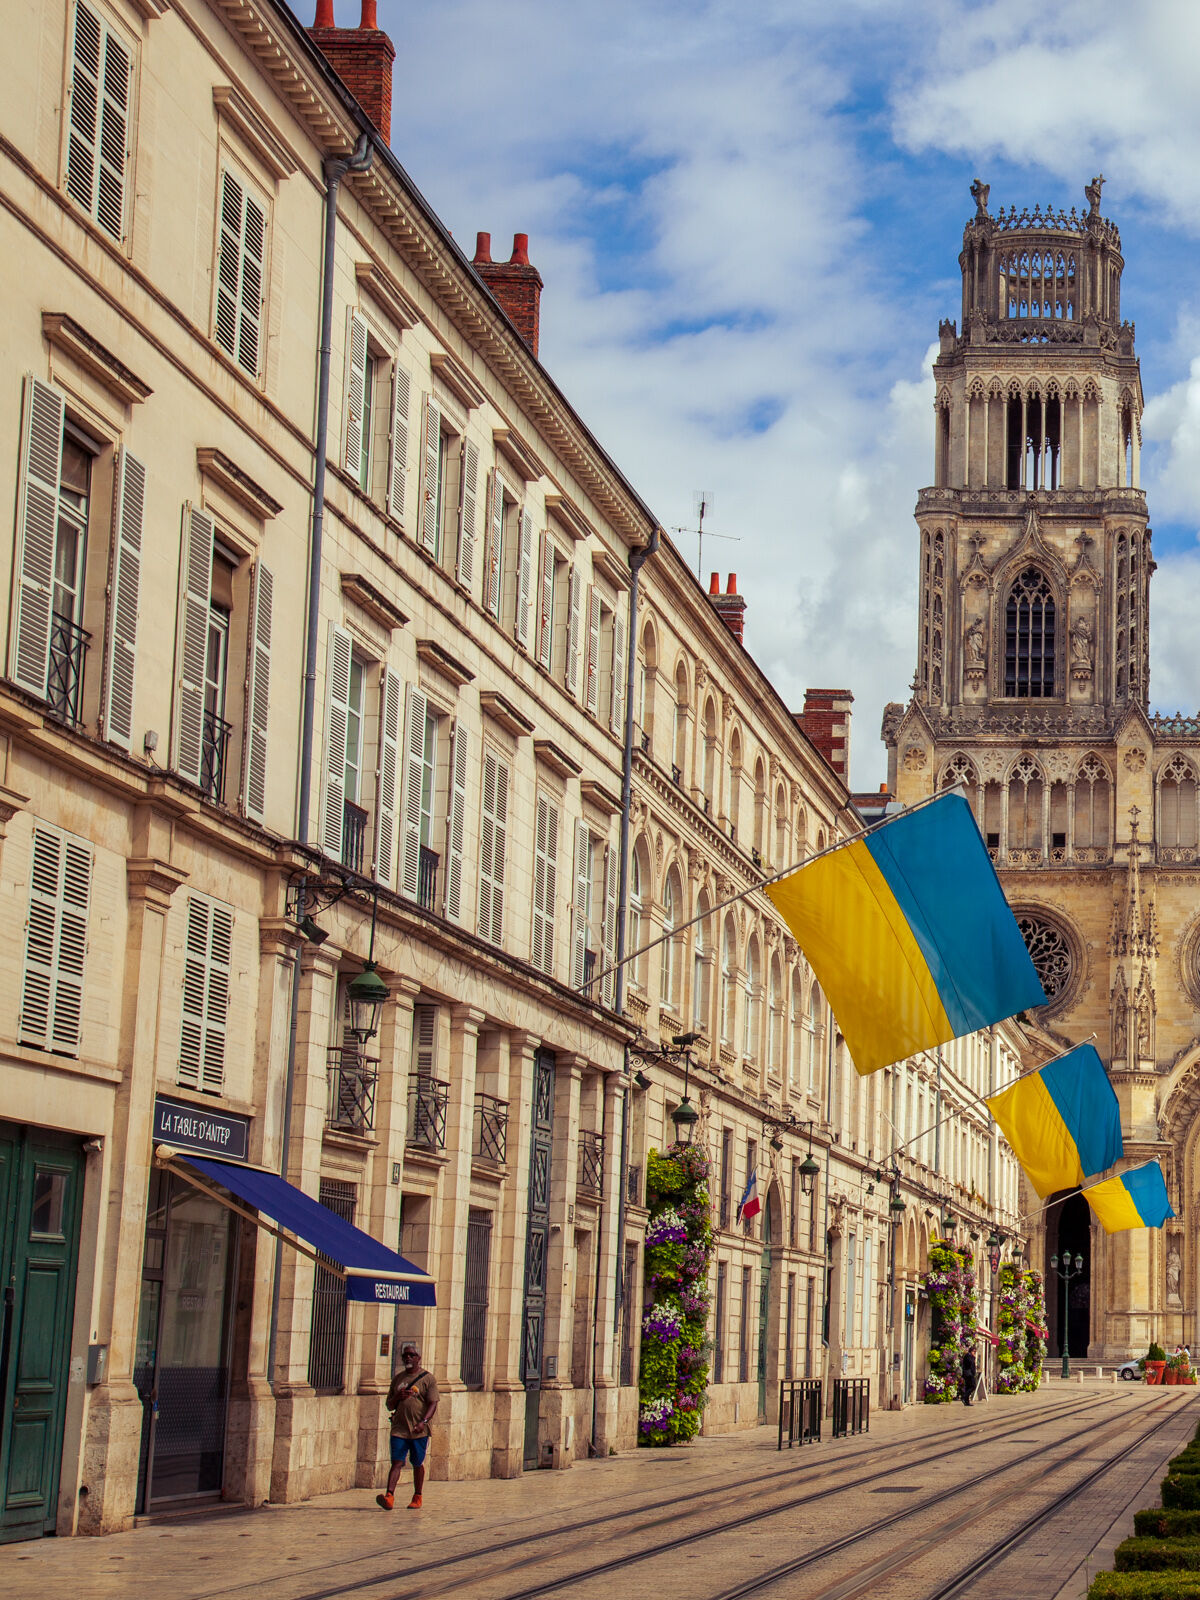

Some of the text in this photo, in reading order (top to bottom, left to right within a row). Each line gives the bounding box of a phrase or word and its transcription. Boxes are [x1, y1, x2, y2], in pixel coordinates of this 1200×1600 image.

[161, 1111, 231, 1146] LA TABLE D'ANTEP
[375, 1283, 410, 1301] RESTAURANT
